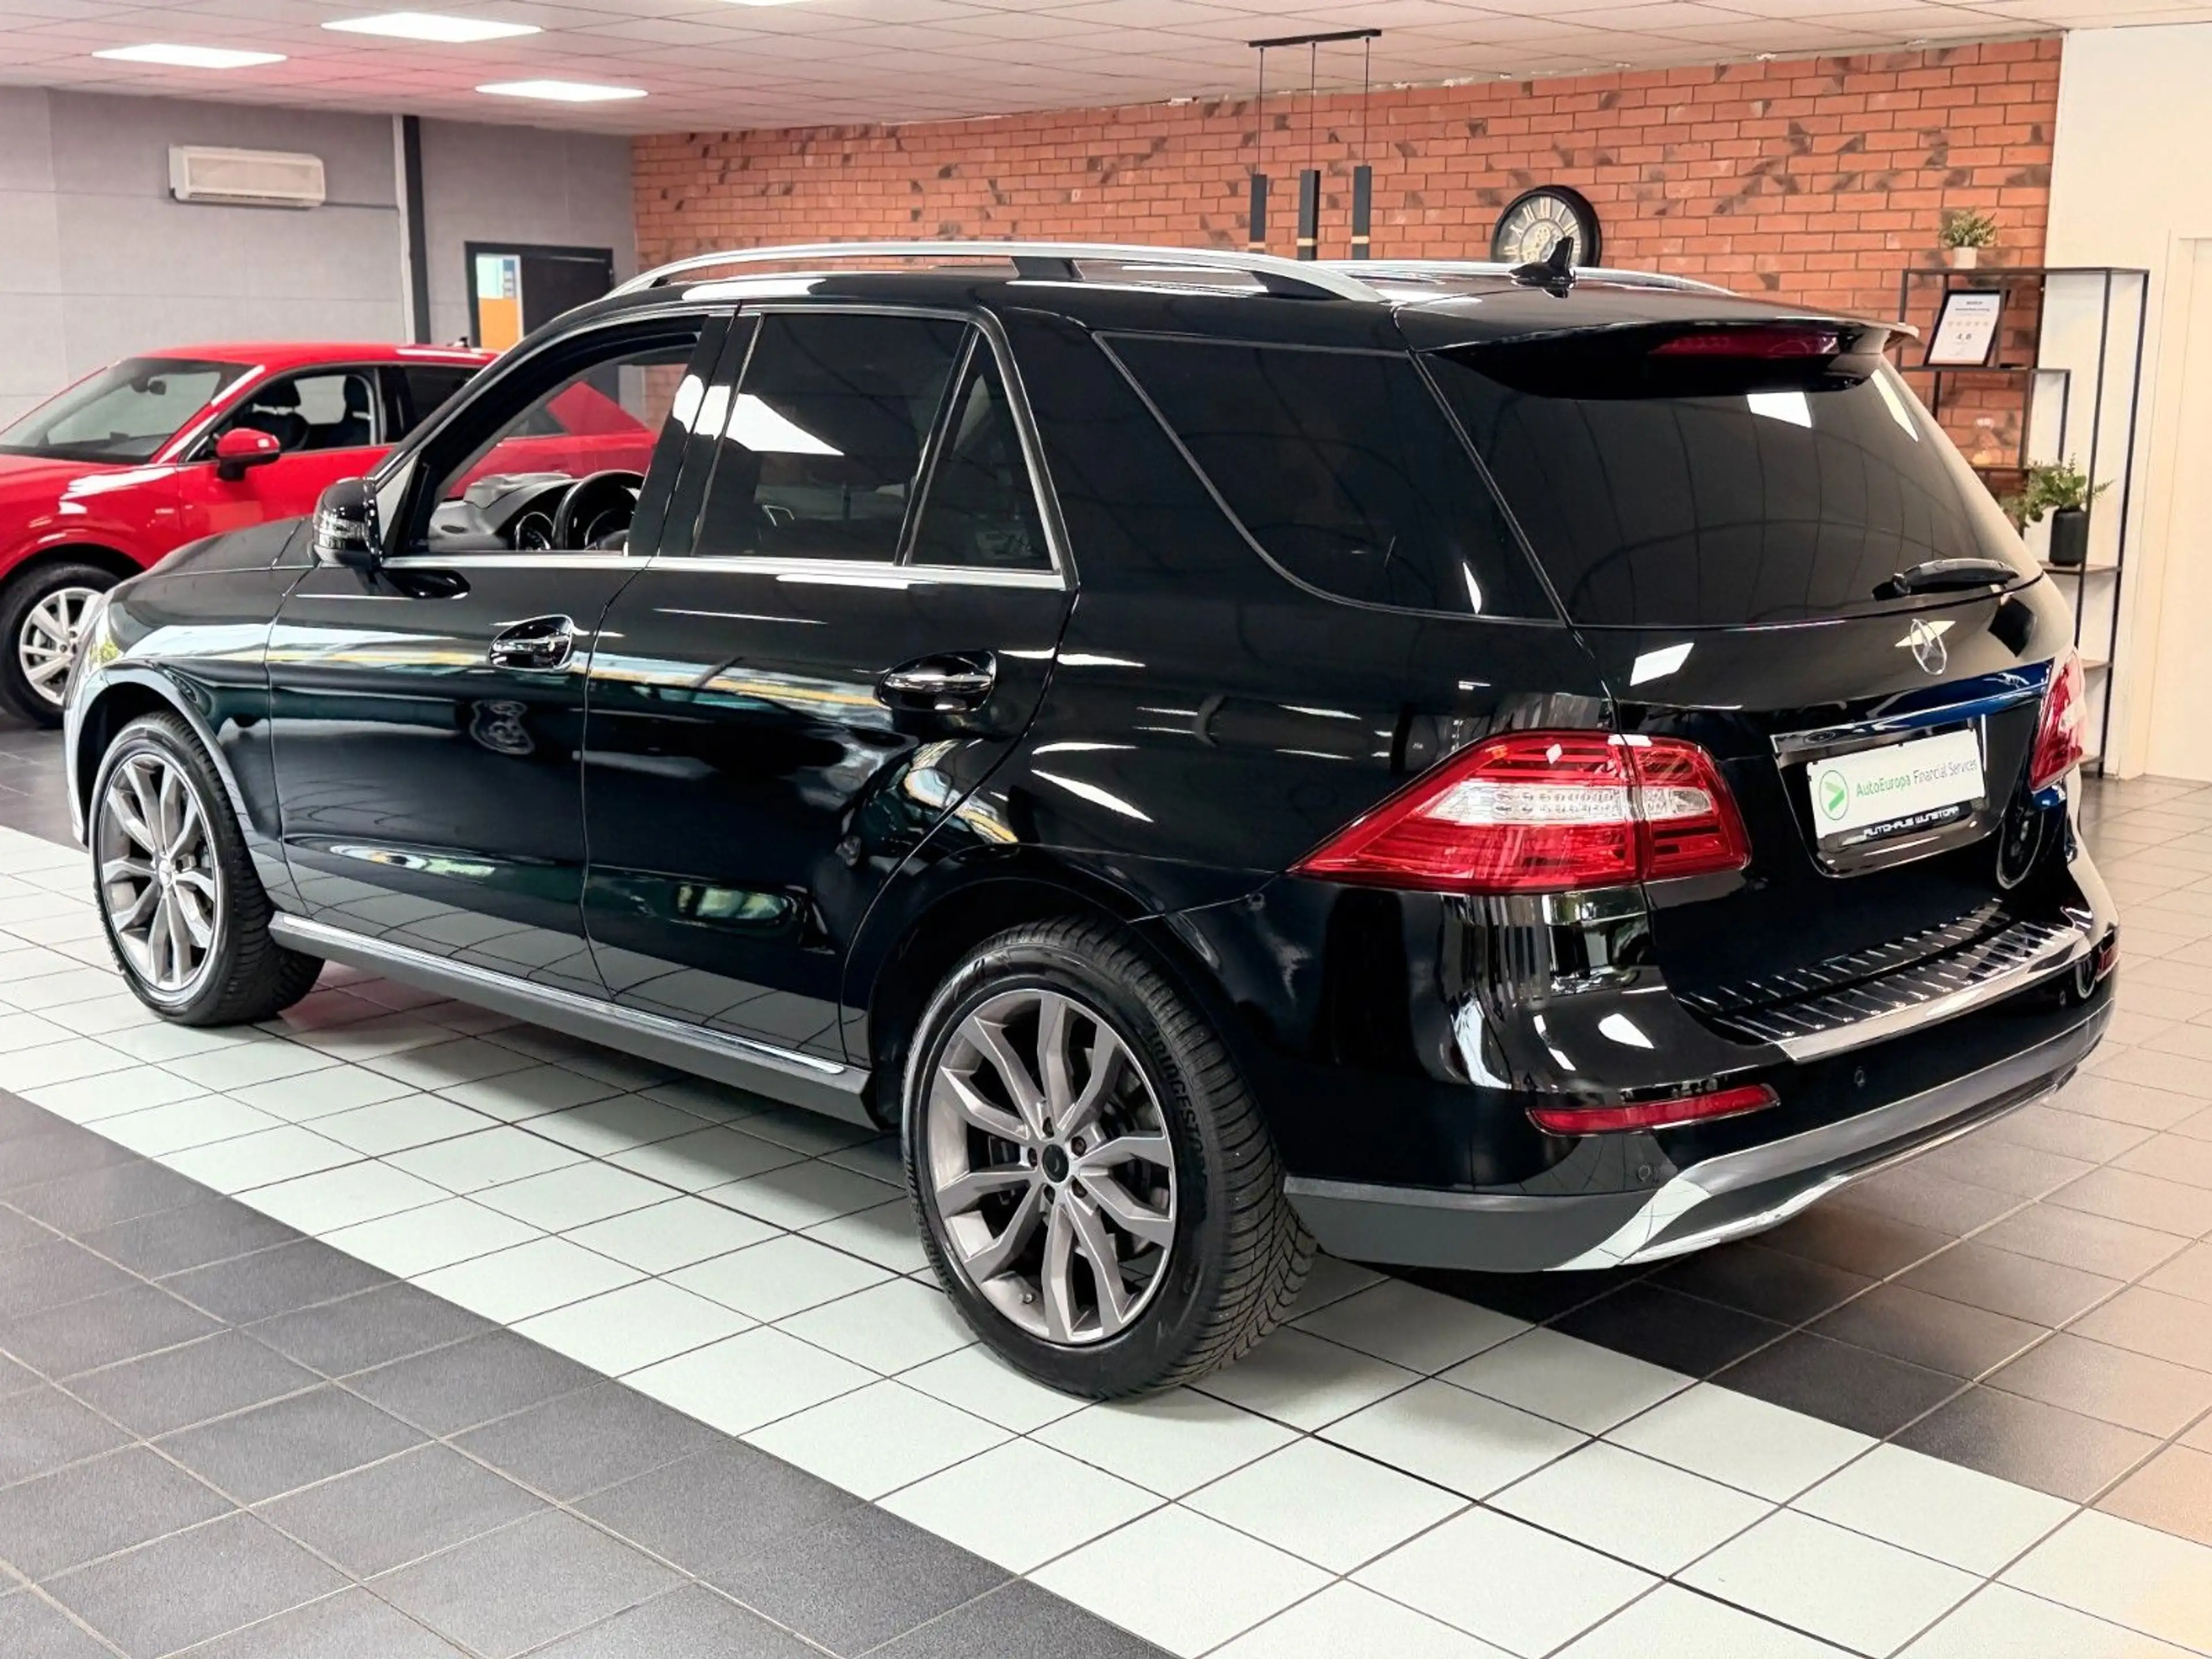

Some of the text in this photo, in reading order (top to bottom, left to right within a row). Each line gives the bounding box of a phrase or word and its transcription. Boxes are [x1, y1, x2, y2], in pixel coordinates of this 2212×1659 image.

[1856, 759, 1977, 798] AutoEuropa Financial Services
